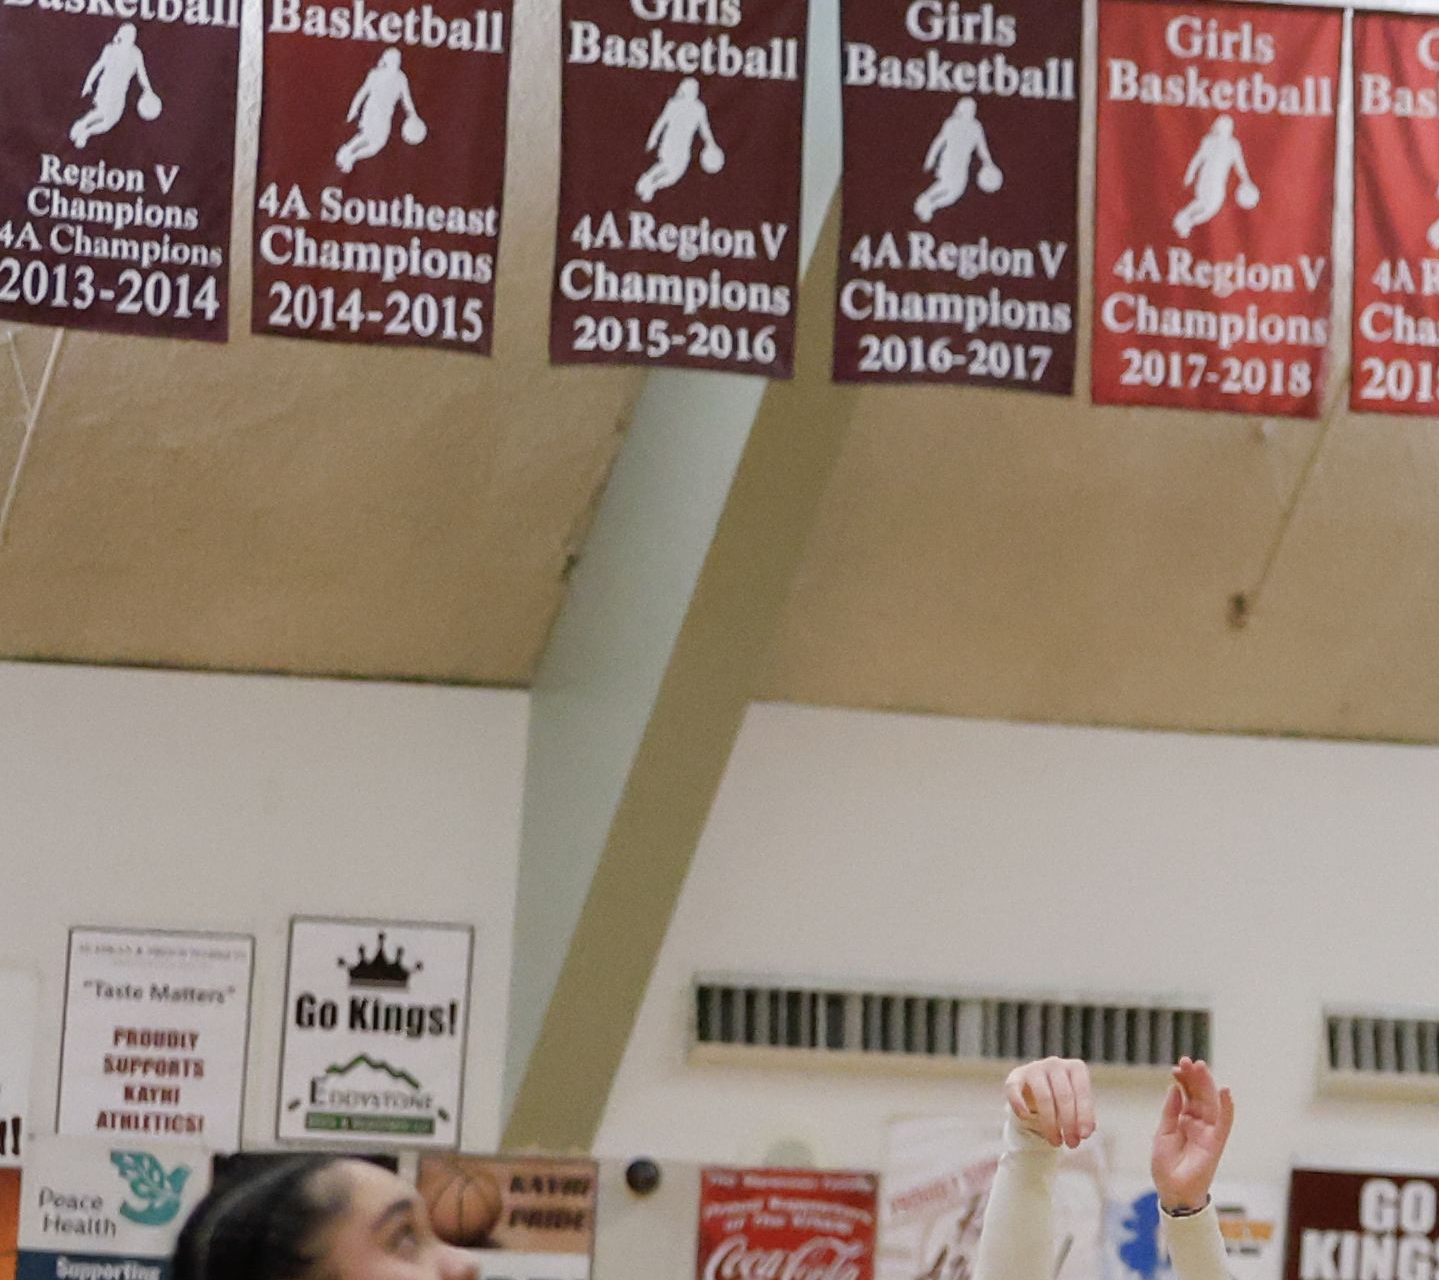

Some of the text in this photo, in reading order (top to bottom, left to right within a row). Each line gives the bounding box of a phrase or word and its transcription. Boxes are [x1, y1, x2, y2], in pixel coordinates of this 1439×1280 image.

[568, 20, 798, 81] Basketball
[1165, 15, 1276, 65] Girls
[843, 41, 1076, 101] Basketball
[1107, 58, 1333, 116] Basketball
[40, 154, 179, 195] Region V
[27, 186, 199, 231] Champions
[259, 182, 499, 237] 4A Southeast
[0, 223, 223, 268] 4A Champions
[260, 225, 494, 283] Champions
[572, 211, 789, 262] 4A Region V
[850, 231, 1068, 281] 4A Region V
[0, 257, 220, 320] 2013-2014
[560, 260, 791, 317] Champions
[1112, 246, 1326, 297] 4A Region V
[1372, 259, 1416, 294] 4A
[268, 281, 485, 343] 2014-2015
[839, 279, 1072, 334] Champions
[1101, 292, 1328, 349] Champions
[573, 315, 778, 364] 2015-2016
[858, 334, 1053, 382] 2016-2017
[1120, 347, 1312, 396] 2017-2018
[114, 1027, 199, 1050] PROUDLY
[295, 992, 457, 1039] Go Kings!
[104, 1053, 204, 1078] SUPPORTS
[39, 1187, 103, 1212] Peace
[1359, 1178, 1438, 1237] GO
[43, 1214, 117, 1238] Health
